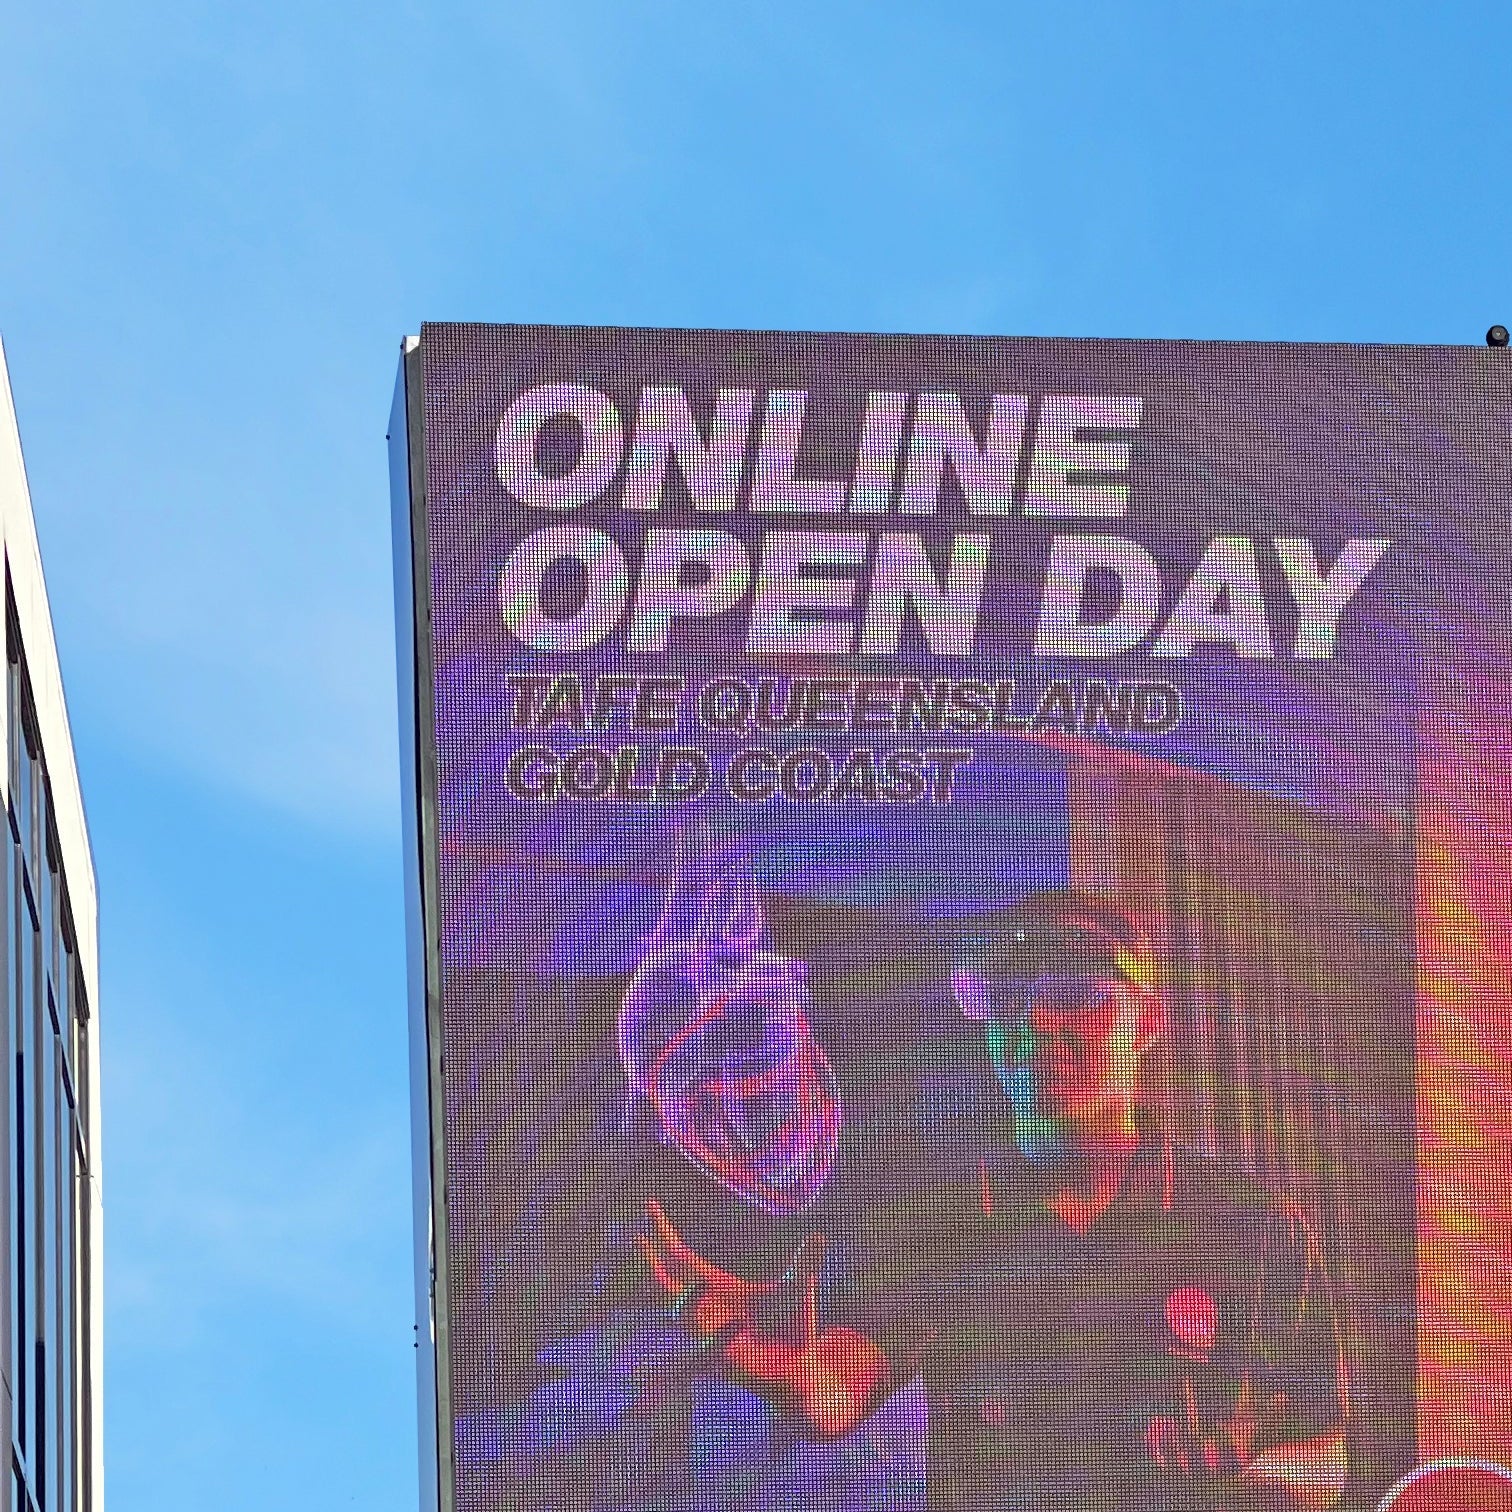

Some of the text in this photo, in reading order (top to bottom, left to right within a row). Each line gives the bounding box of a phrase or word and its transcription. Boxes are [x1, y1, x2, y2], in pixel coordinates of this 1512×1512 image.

[495, 381, 1145, 517] ONLINE
[499, 523, 1392, 659] OPEN DAY
[503, 672, 1184, 738] TAFE QUEENSLAND
[503, 744, 975, 804] GOLD COAST
